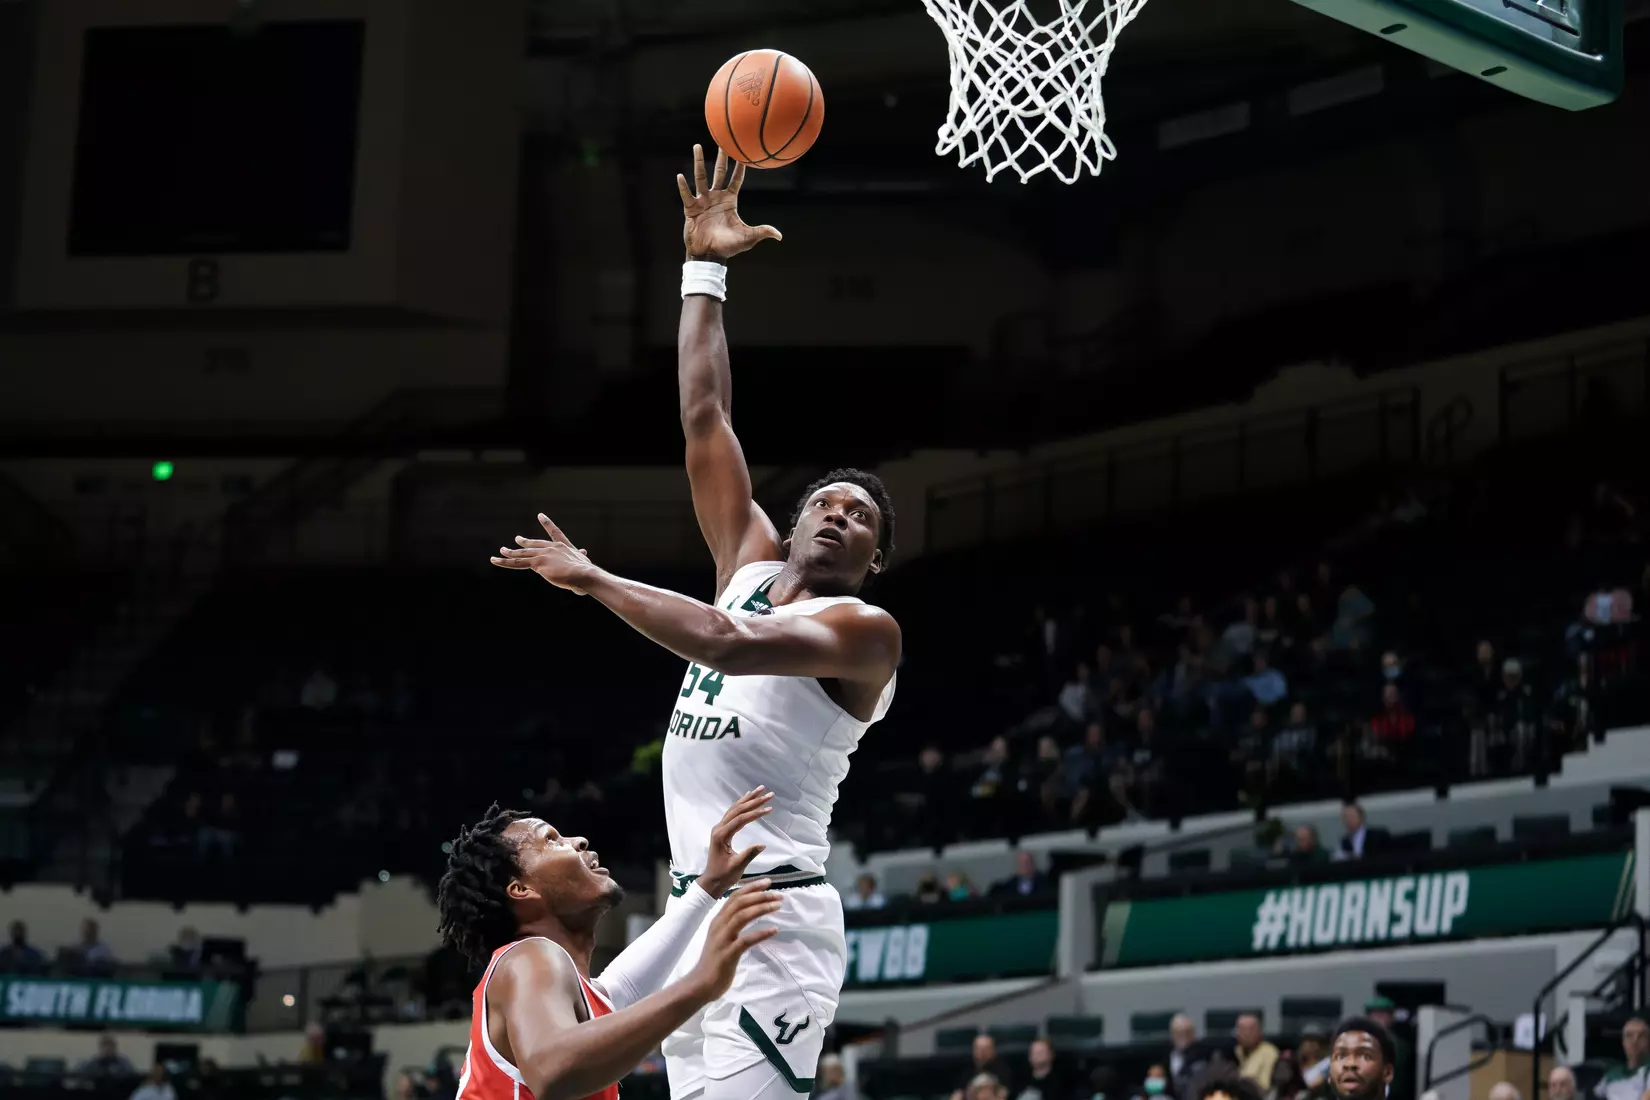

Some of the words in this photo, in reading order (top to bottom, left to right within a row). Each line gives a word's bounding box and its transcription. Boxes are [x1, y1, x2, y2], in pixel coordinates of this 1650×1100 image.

[1252, 869, 1469, 951] #HORNSUP
[6, 982, 91, 1017] SOUTH
[93, 984, 203, 1023] FLORIDA
